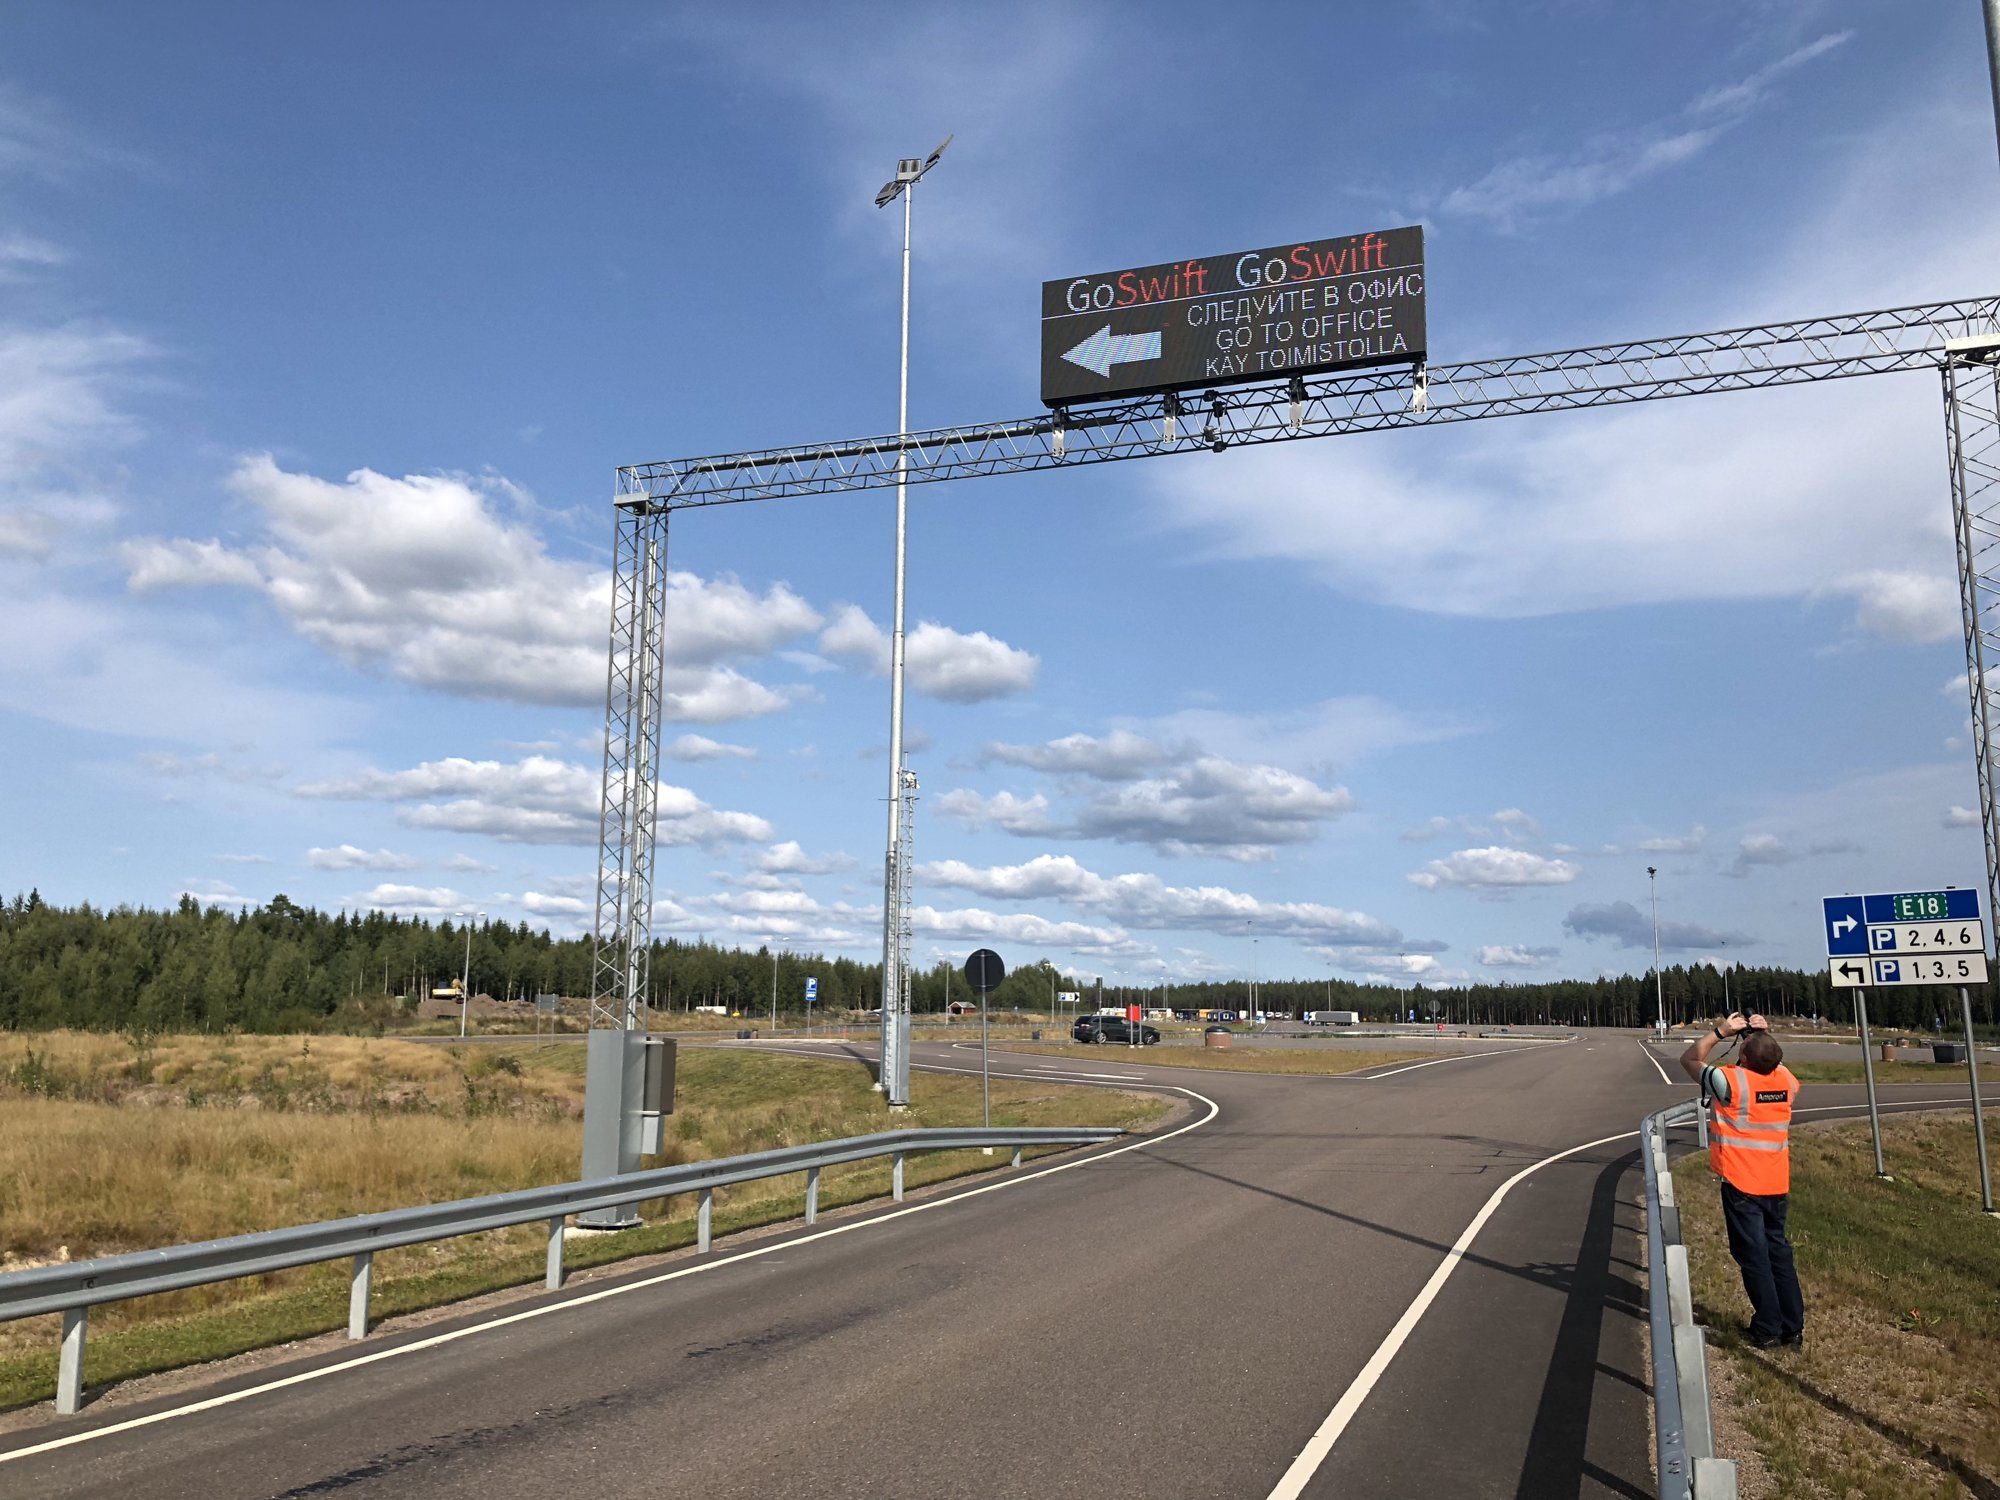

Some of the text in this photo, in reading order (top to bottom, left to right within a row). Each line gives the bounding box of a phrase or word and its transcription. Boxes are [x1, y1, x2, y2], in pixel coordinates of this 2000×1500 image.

[1066, 233, 1389, 313] GoSwift GoSwift
[1347, 273, 1423, 304] ОФИС
[1216, 306, 1393, 350] GO TO OFFICE
[1206, 333, 1408, 377] KÄY TOIMISTOLLA
[1902, 897, 1940, 916] E18
[1875, 929, 1893, 950] P
[1879, 961, 1897, 981] P
